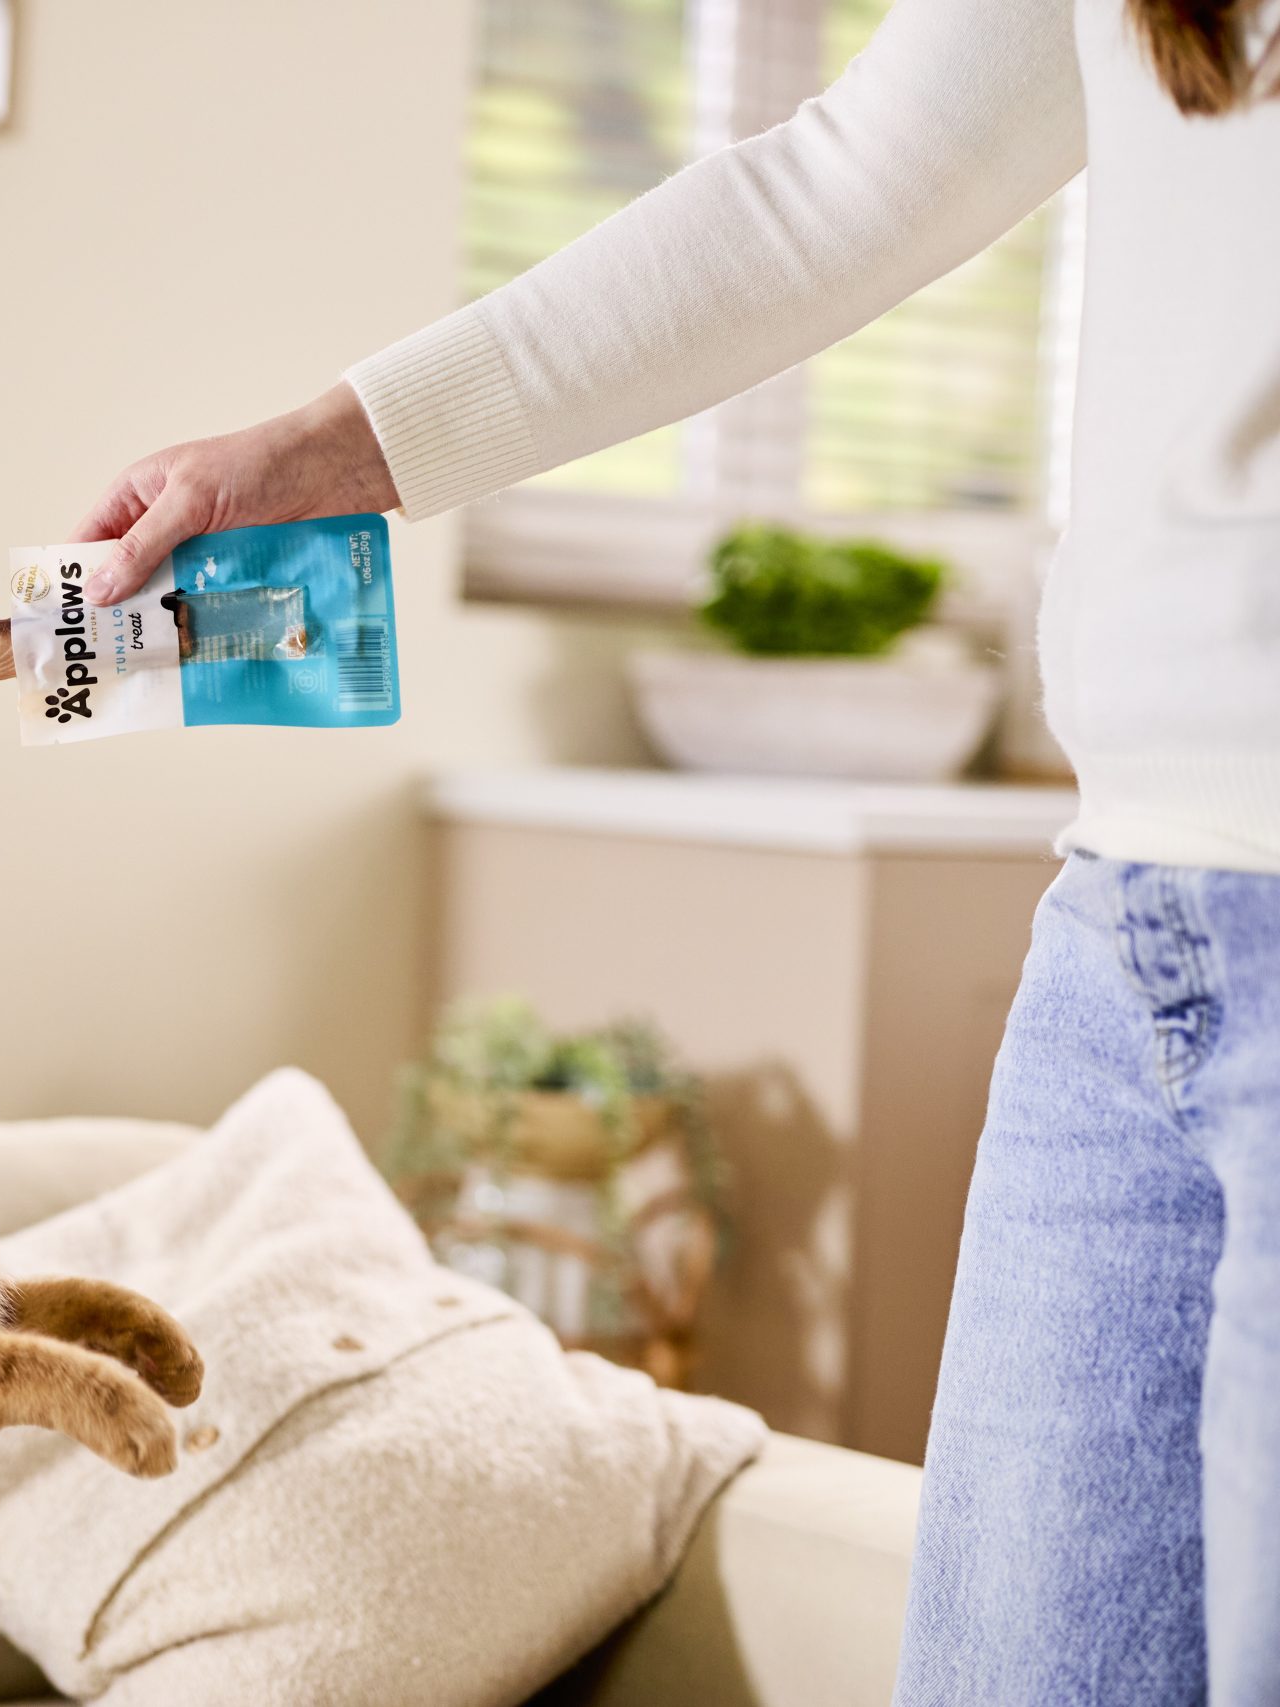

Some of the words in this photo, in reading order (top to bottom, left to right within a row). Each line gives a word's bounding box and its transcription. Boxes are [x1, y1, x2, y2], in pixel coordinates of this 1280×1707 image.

[349, 533, 359, 550] WT:
[350, 551, 361, 567] NET
[16, 573, 26, 594] 100%
[23, 564, 38, 603] NATURAL
[54, 562, 98, 718] Applaws
[128, 612, 144, 650] treat
[115, 634, 127, 674] TUNA
